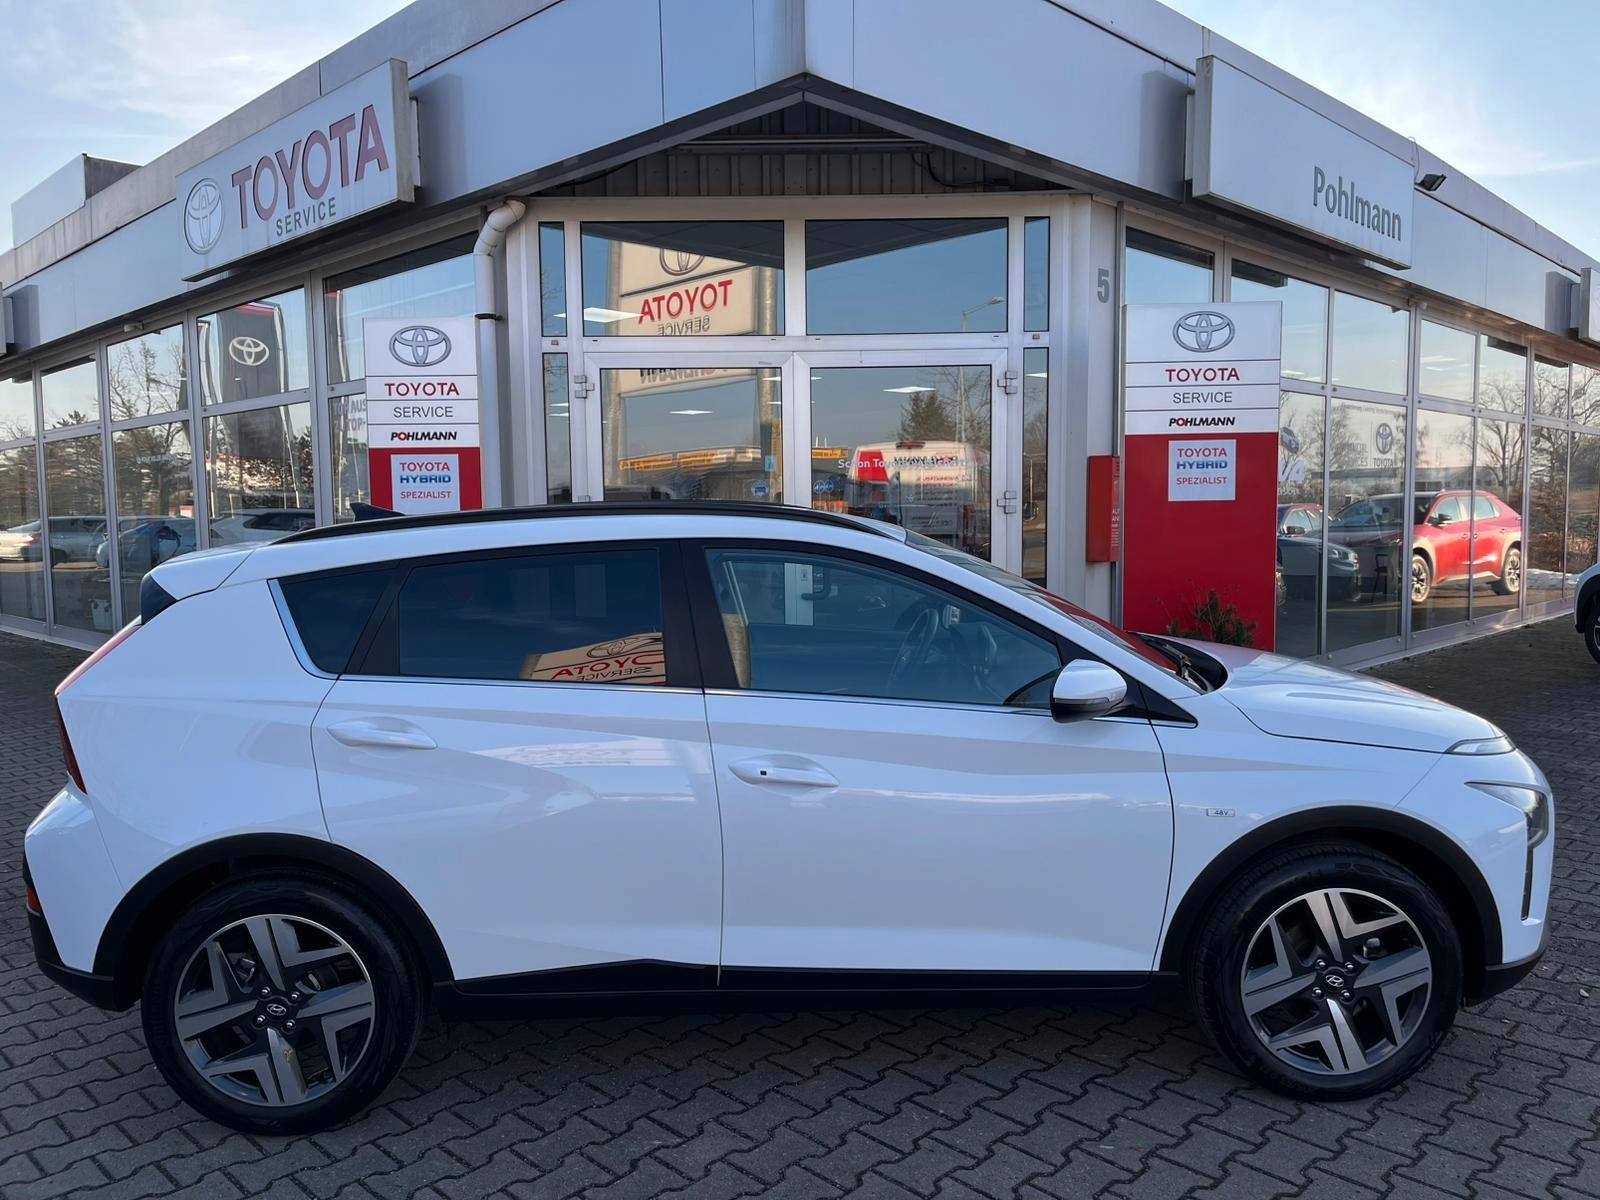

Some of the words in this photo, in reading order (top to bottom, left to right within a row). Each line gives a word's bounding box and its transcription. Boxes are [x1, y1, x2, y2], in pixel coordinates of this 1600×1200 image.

[232, 104, 389, 229] TOYOTA
[1313, 166, 1402, 241] Pohlmann
[276, 197, 337, 236] SERVICE
[1097, 268, 1110, 304] 5
[1165, 368, 1240, 382] TOYOTA
[384, 382, 460, 396] TOYOTA
[1172, 391, 1233, 404] SERVICE
[393, 406, 454, 418] SERVICE
[1168, 416, 1236, 427] POHLMANN
[390, 431, 458, 441] POHLMANN
[1177, 447, 1228, 458] TOYOTA
[399, 462, 451, 472] TOYOTA
[1176, 460, 1228, 470] HYBRID
[400, 475, 451, 484] HYBRID
[1176, 476, 1228, 485] SPEZIALIST
[400, 491, 451, 499] SPEZIALIST
